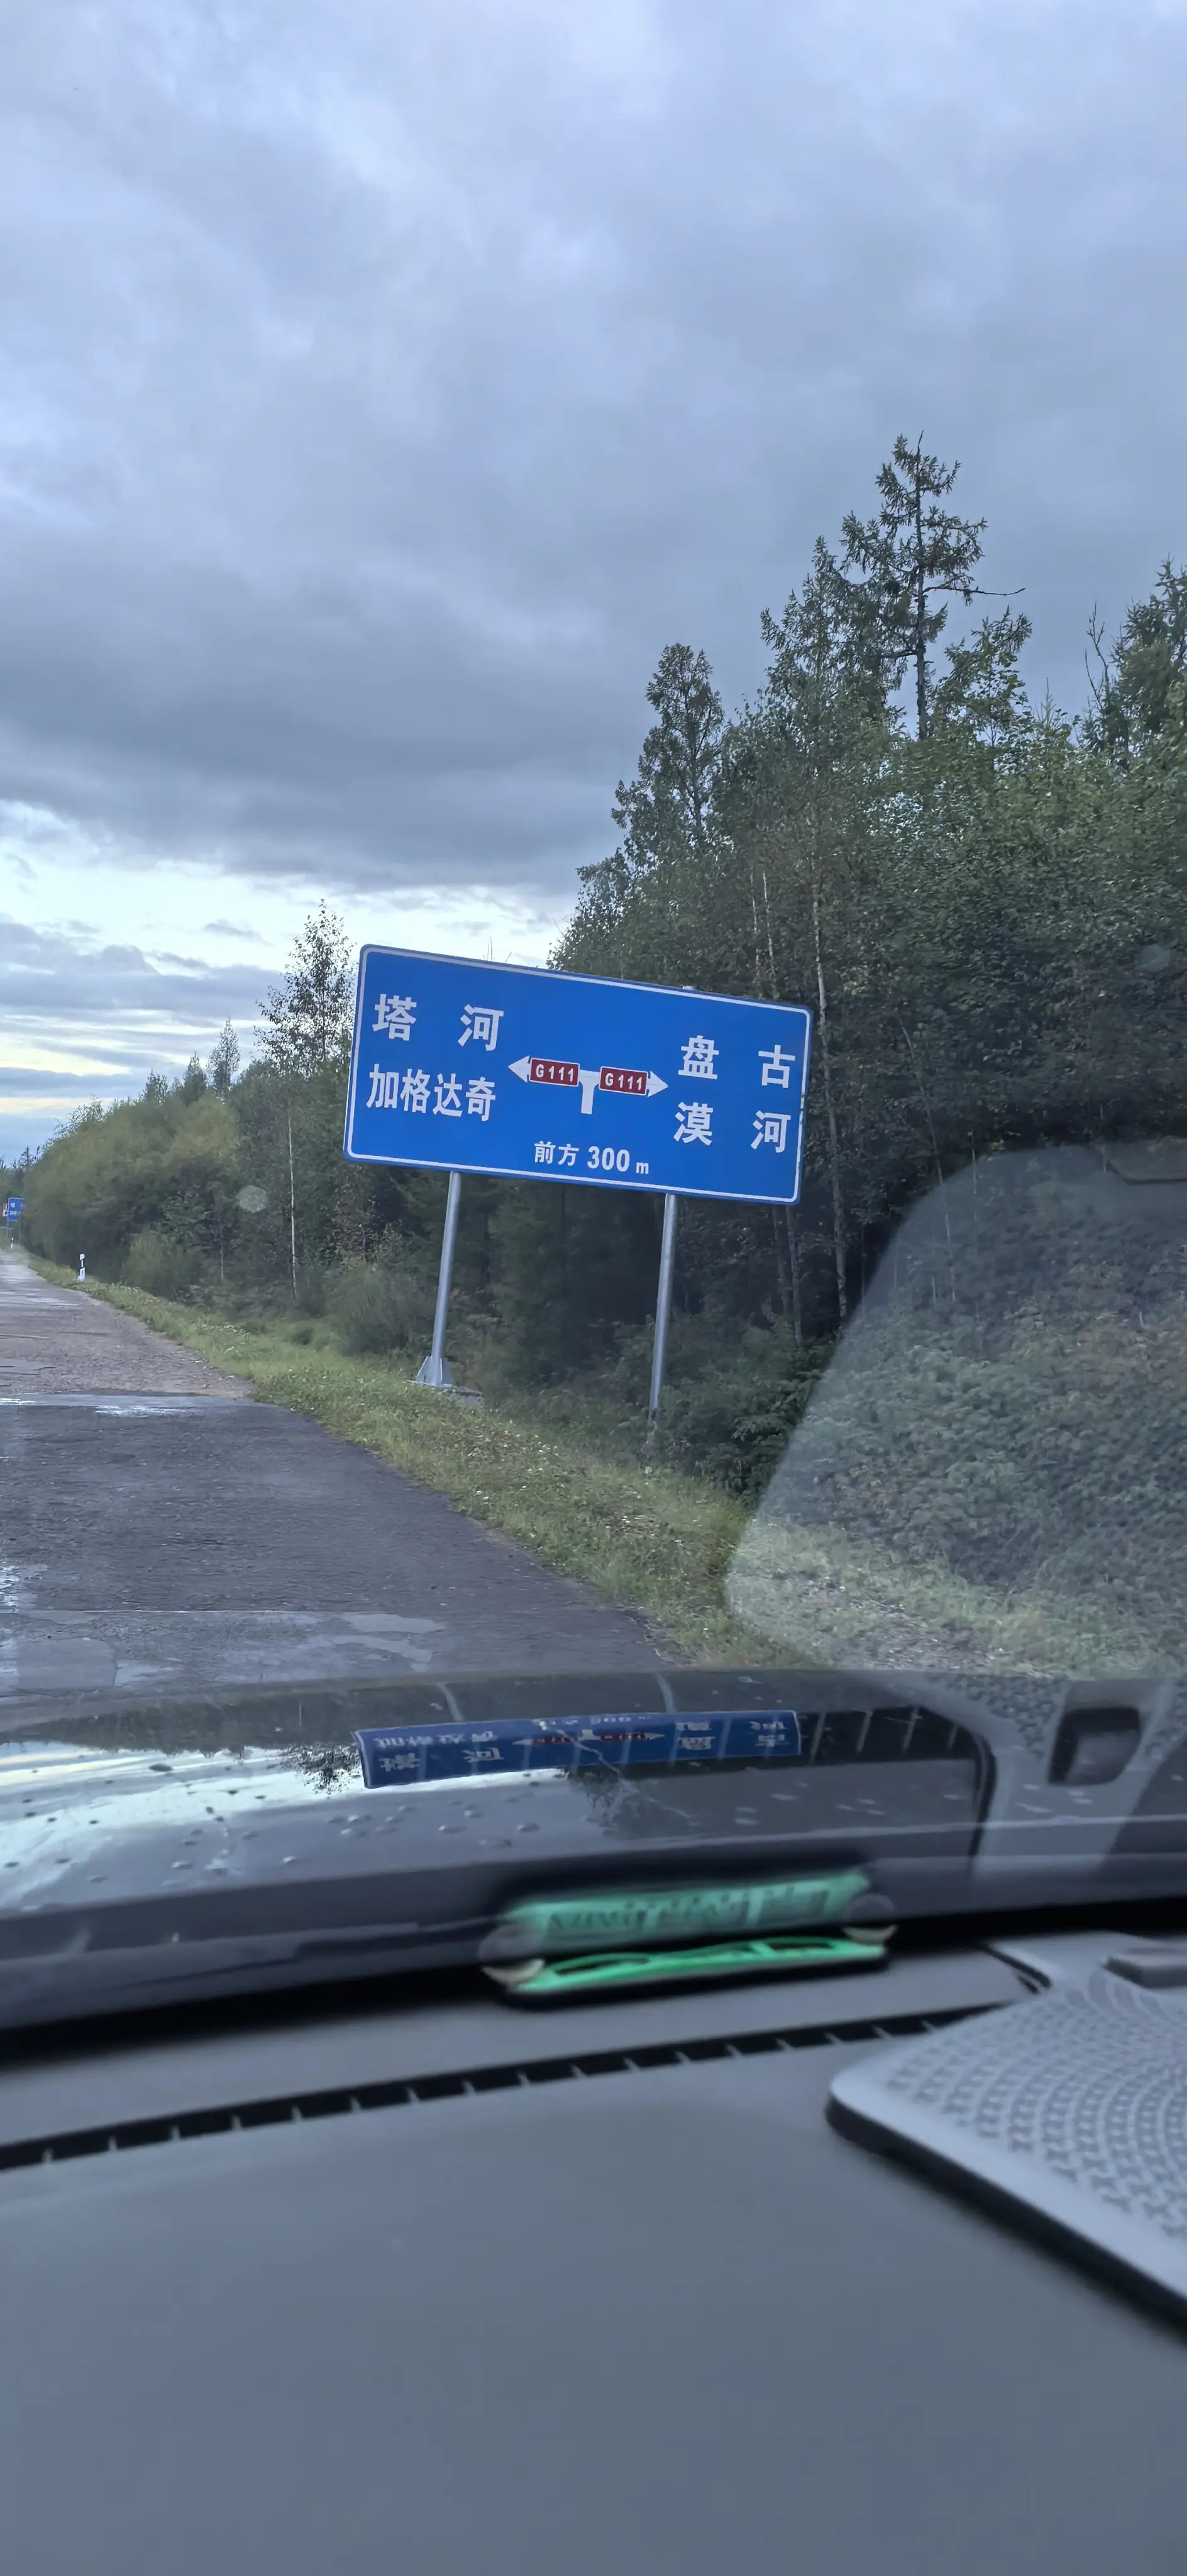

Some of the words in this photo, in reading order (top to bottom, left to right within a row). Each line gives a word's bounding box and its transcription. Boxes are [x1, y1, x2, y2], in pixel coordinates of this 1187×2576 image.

[372, 994, 504, 1051] 塔河
[536, 1063, 579, 1082] G111
[605, 1072, 643, 1091] G111
[678, 1035, 796, 1089] 盘古
[367, 1064, 496, 1121] 加格达奇
[674, 1102, 792, 1153] 漠河
[534, 1141, 580, 1166] 前方
